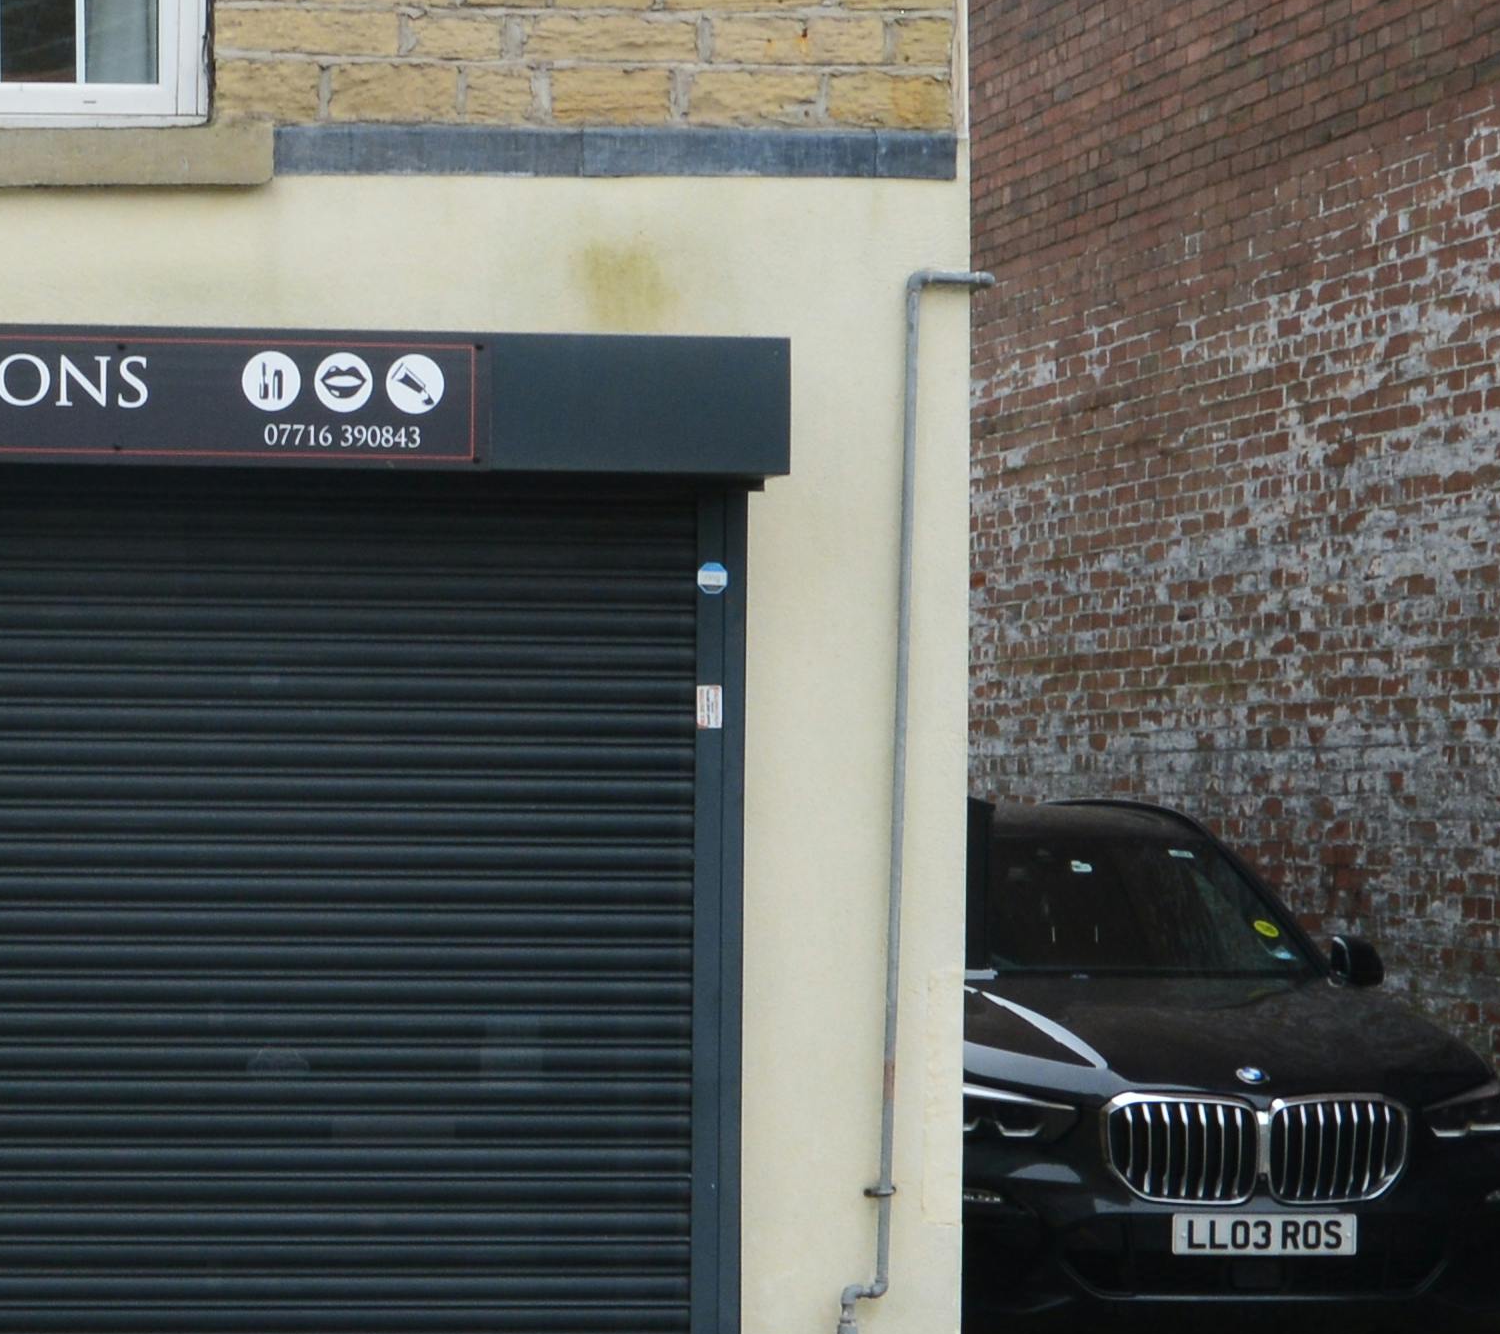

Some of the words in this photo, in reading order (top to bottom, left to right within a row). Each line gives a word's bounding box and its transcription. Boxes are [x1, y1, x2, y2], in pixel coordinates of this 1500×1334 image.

[264, 423, 333, 447] 07716
[340, 424, 422, 449] 390843
[1186, 1219, 1272, 1251] LL03
[1281, 1220, 1343, 1250] ROS
